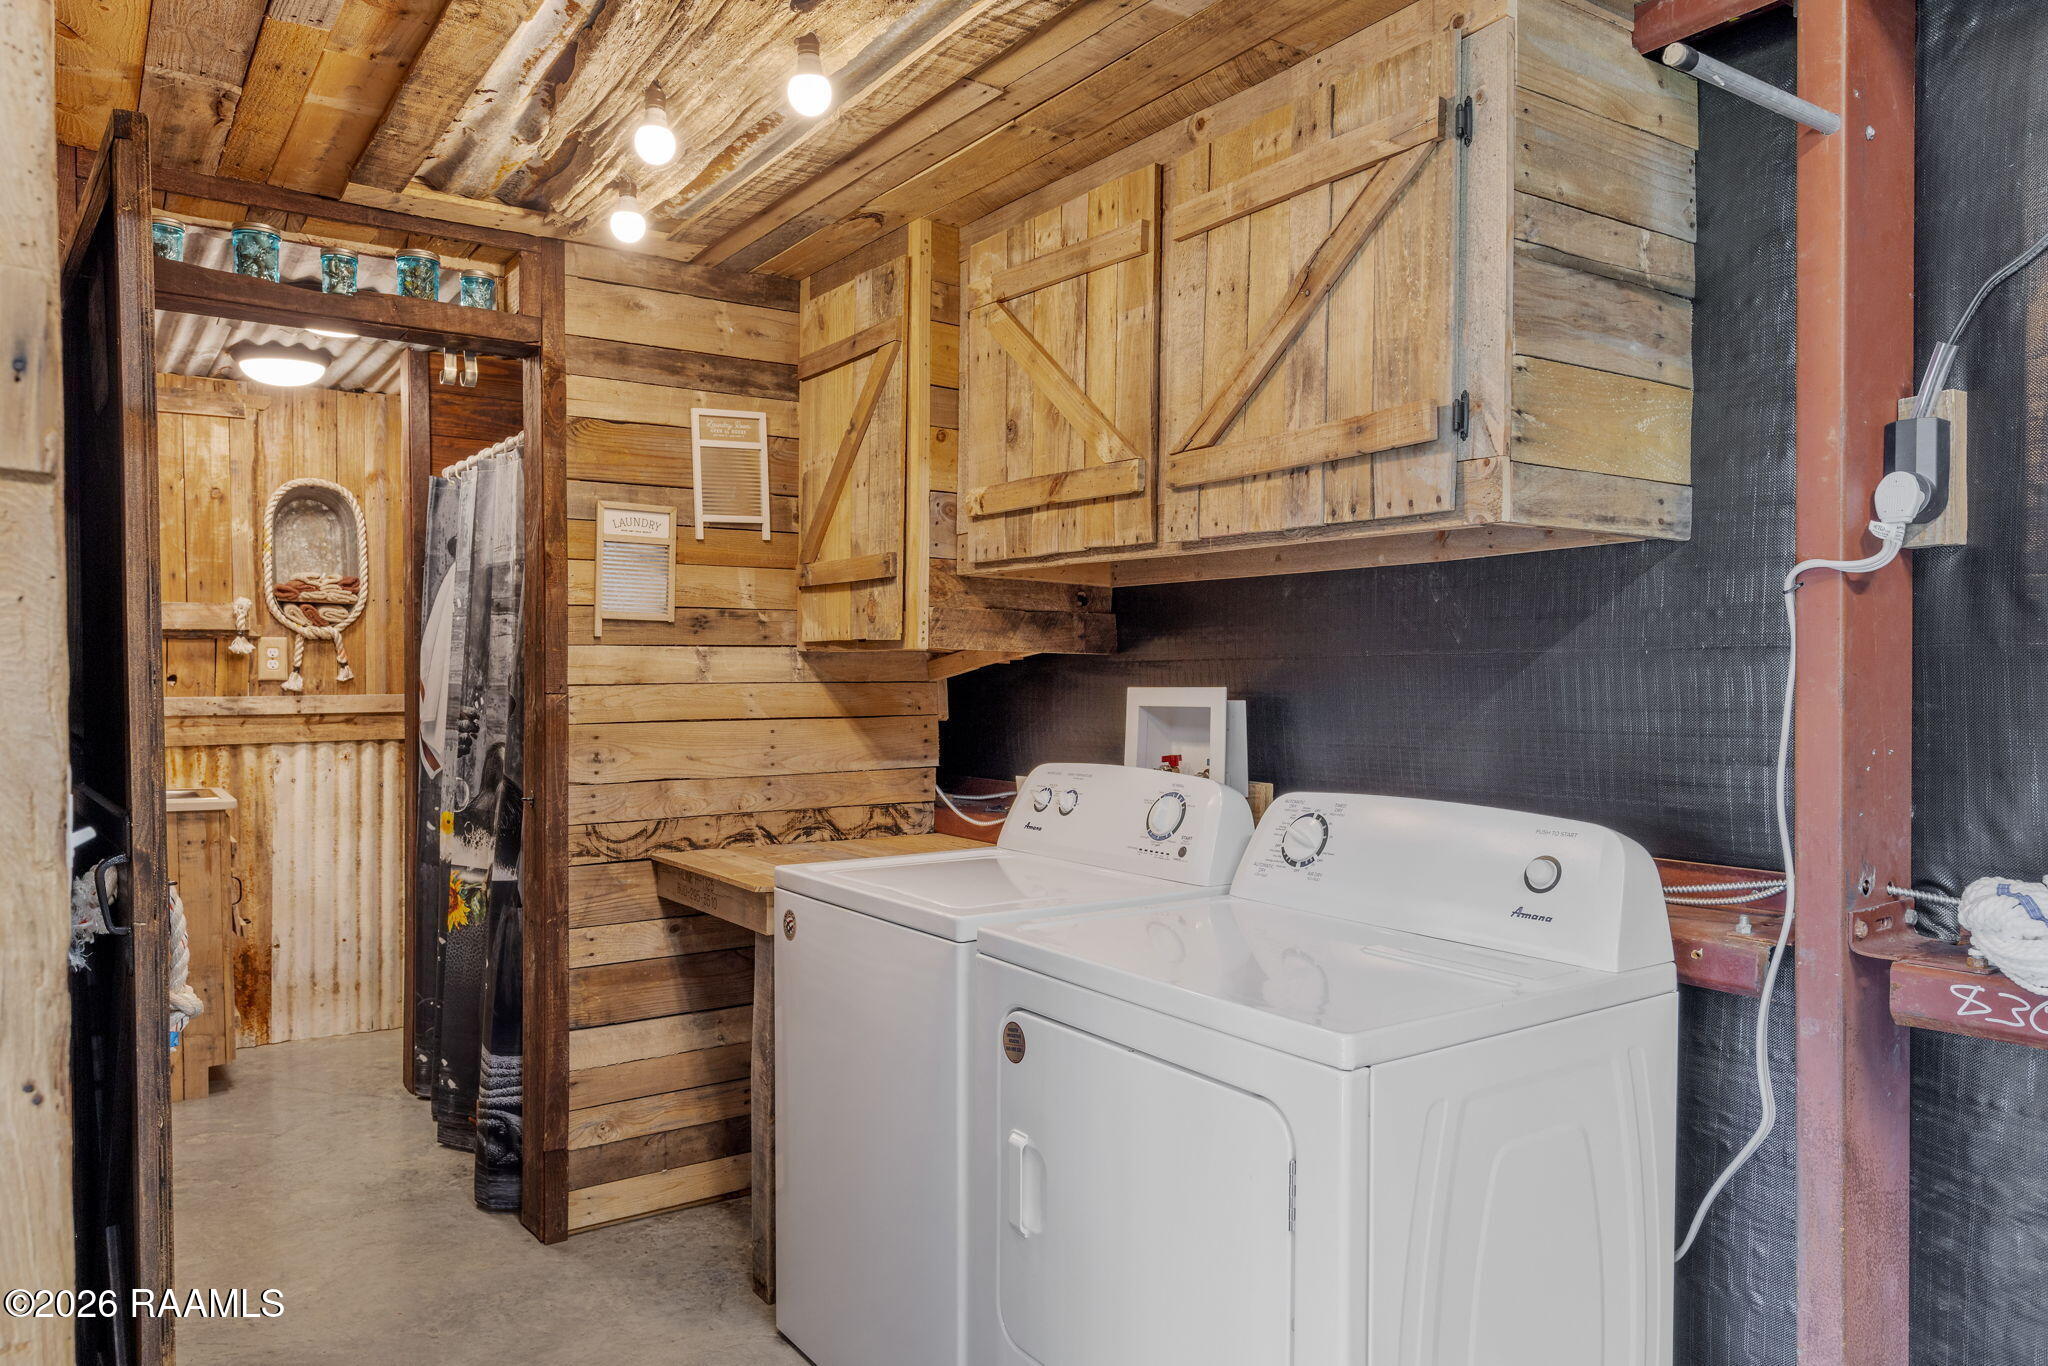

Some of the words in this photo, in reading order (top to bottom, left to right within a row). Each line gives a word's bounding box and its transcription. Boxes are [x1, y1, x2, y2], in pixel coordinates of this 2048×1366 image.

[612, 517, 662, 531] LAUNDRY
[1023, 821, 1043, 832] Amana
[1510, 906, 1553, 923] Amana
